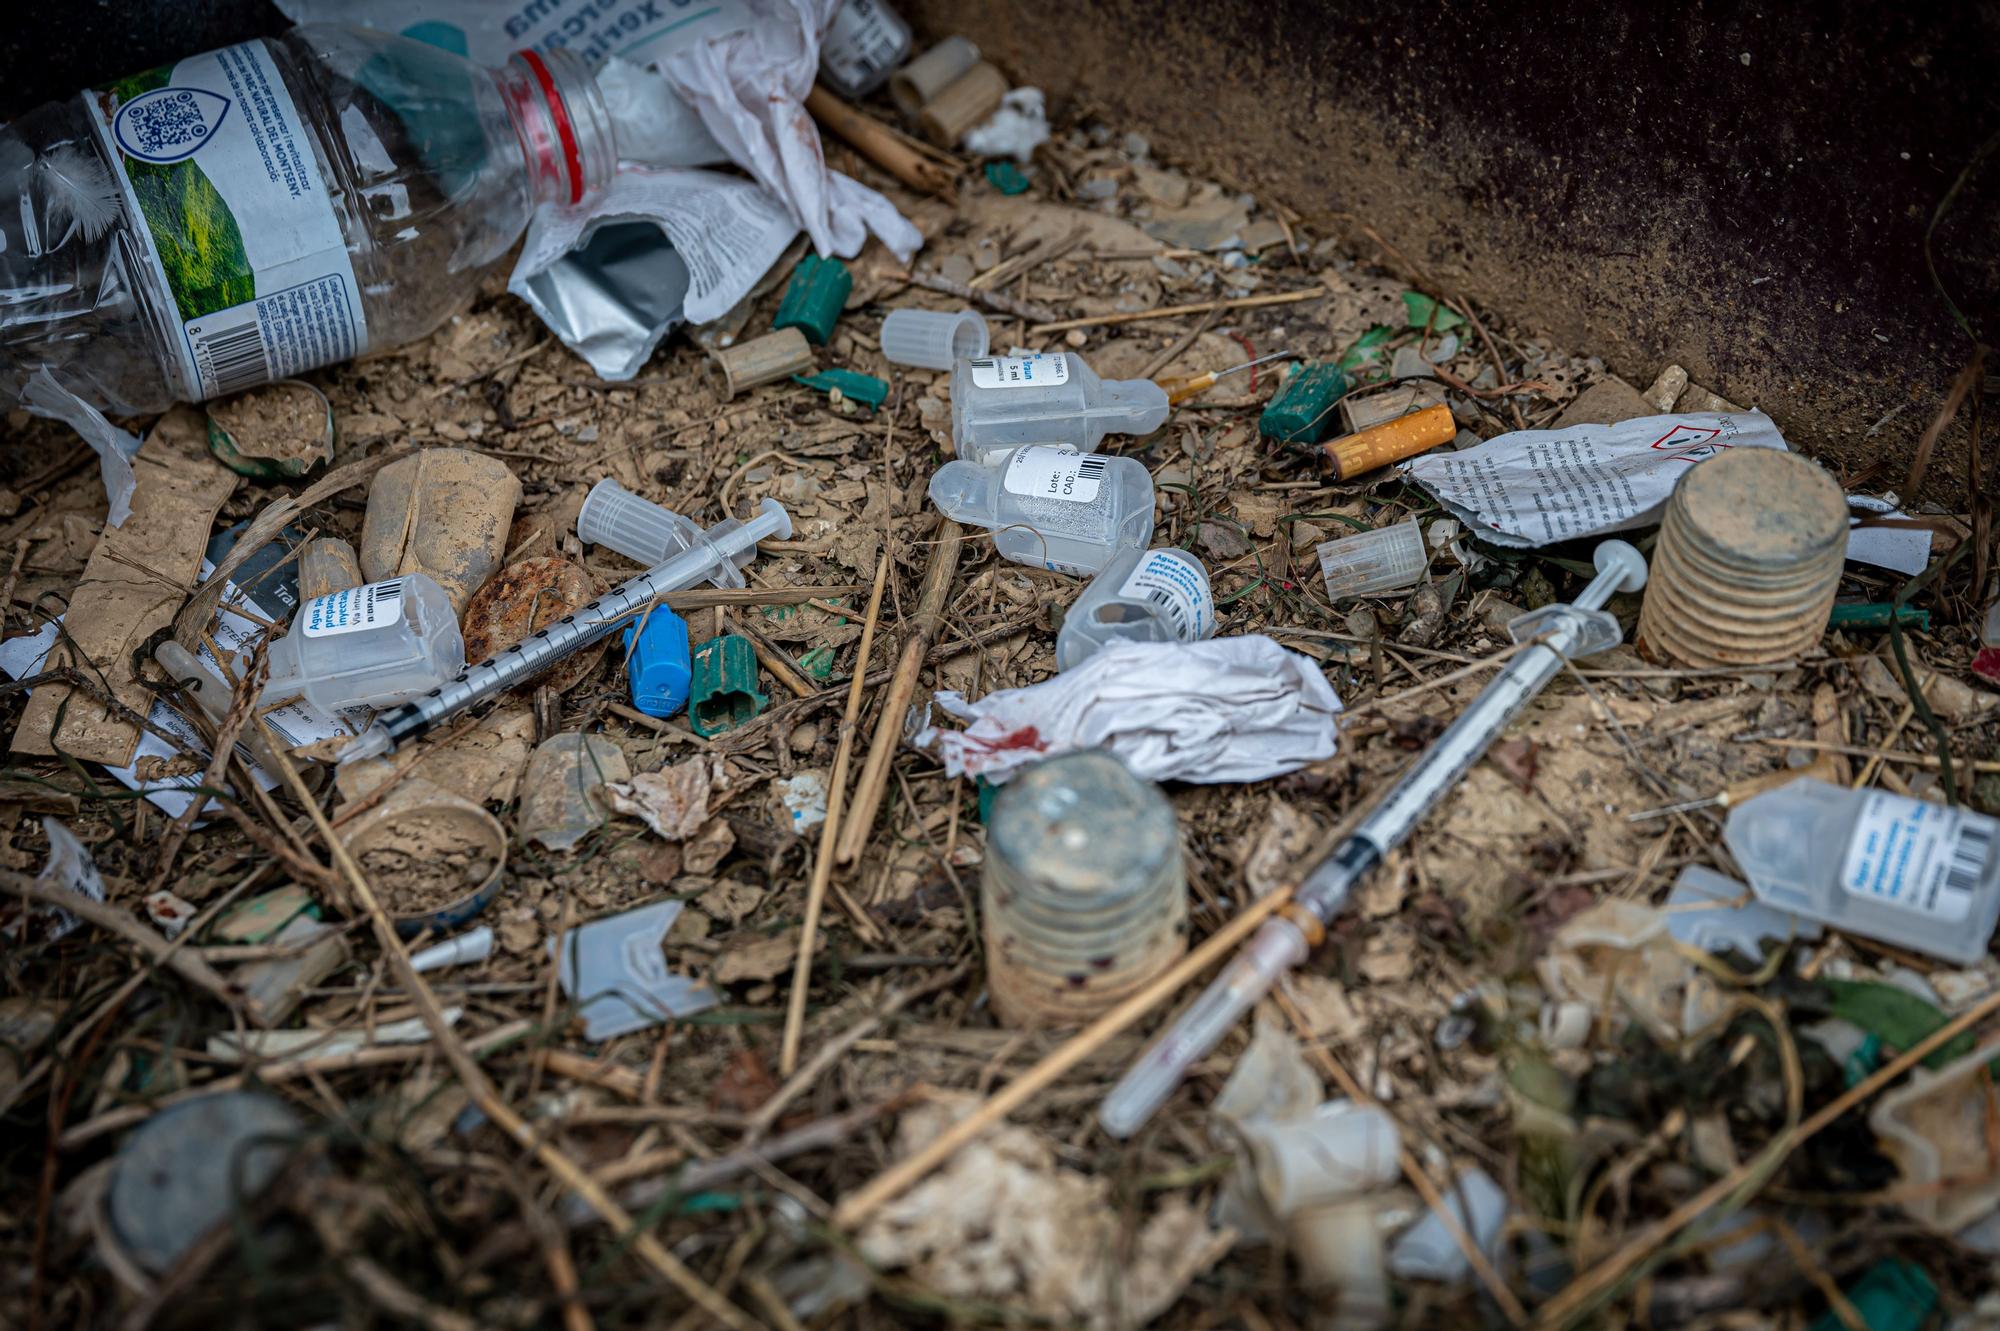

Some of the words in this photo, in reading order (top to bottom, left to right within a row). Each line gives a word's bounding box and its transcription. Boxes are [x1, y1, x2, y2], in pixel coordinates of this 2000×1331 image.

[241, 73, 258, 91] PARC
[237, 97, 254, 122] nostra
[249, 90, 273, 126] NATURAL
[263, 95, 289, 135] preservar
[284, 138, 311, 191] revitalitzar
[265, 126, 281, 143] DEL
[272, 142, 301, 199] MONTSENY.
[188, 326, 201, 335] 8
[193, 340, 214, 380] 411002
[1010, 370, 1020, 380] ml
[1047, 470, 1060, 493] Lote:
[1063, 469, 1076, 495] CAD.:
[1154, 553, 1179, 567] Agua
[1180, 563, 1199, 582] para
[309, 608, 322, 629] Agua
[301, 713, 313, 724] en
